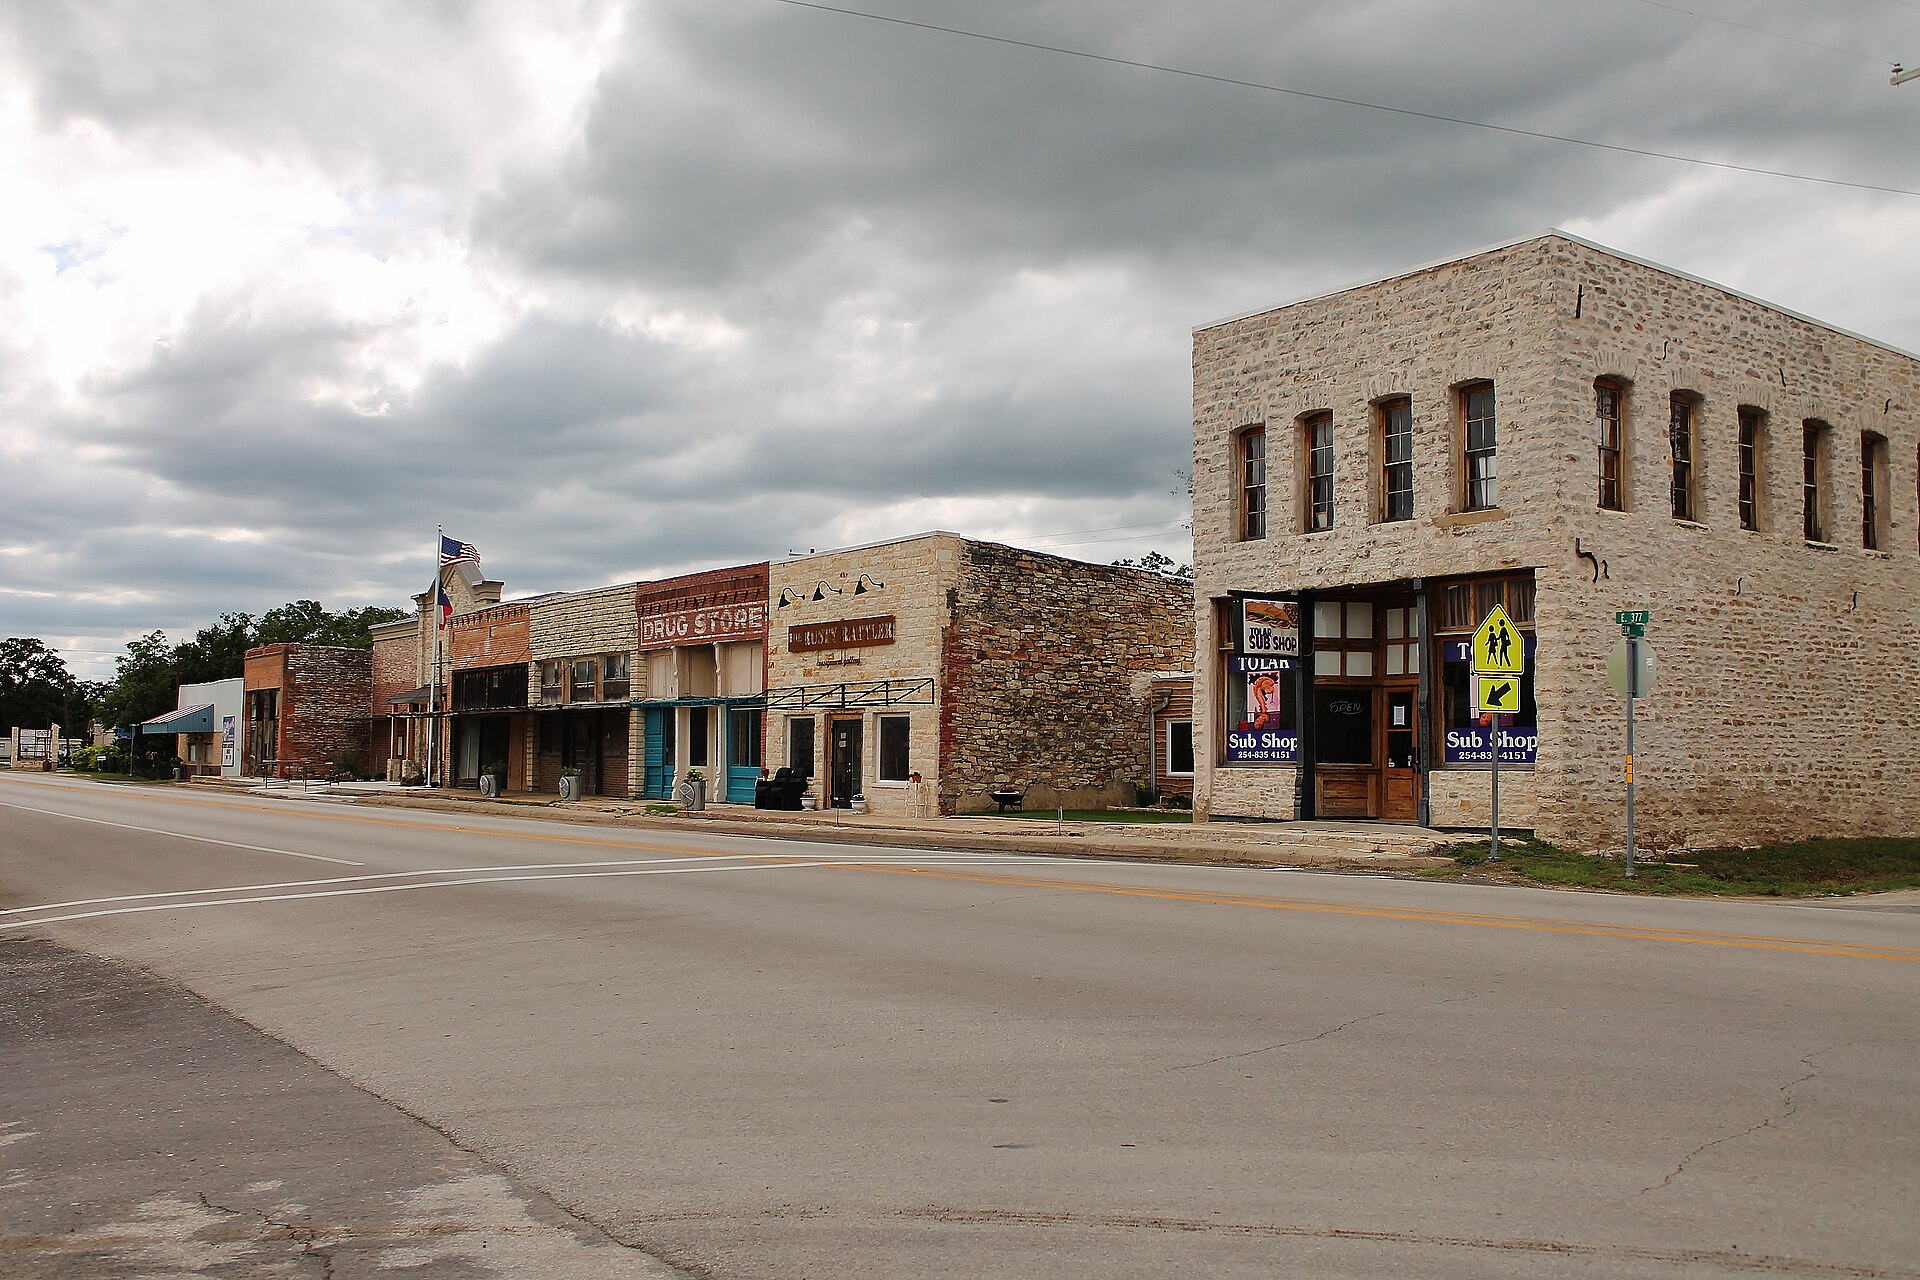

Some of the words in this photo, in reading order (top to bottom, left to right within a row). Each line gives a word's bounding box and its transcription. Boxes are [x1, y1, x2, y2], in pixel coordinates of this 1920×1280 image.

[643, 616, 689, 640] DRUG
[694, 607, 763, 635] STORE
[1620, 613, 1628, 623] E.
[1630, 612, 1643, 622] 377
[804, 626, 838, 646] RUSTY
[841, 622, 894, 643] RATTLER
[1249, 627, 1272, 637] TOLAR
[1248, 635, 1271, 650] SUB
[1273, 636, 1297, 652] SHOP
[1238, 656, 1290, 671] TOLAR
[1330, 702, 1361, 713] OPEN
[1229, 732, 1257, 748] Sub
[1261, 732, 1298, 751] Shop
[1446, 730, 1483, 748] Sub
[1238, 750, 1269, 759] 254-835
[1270, 750, 1290, 759] 4151
[1458, 751, 1527, 760] 254-83-4151
